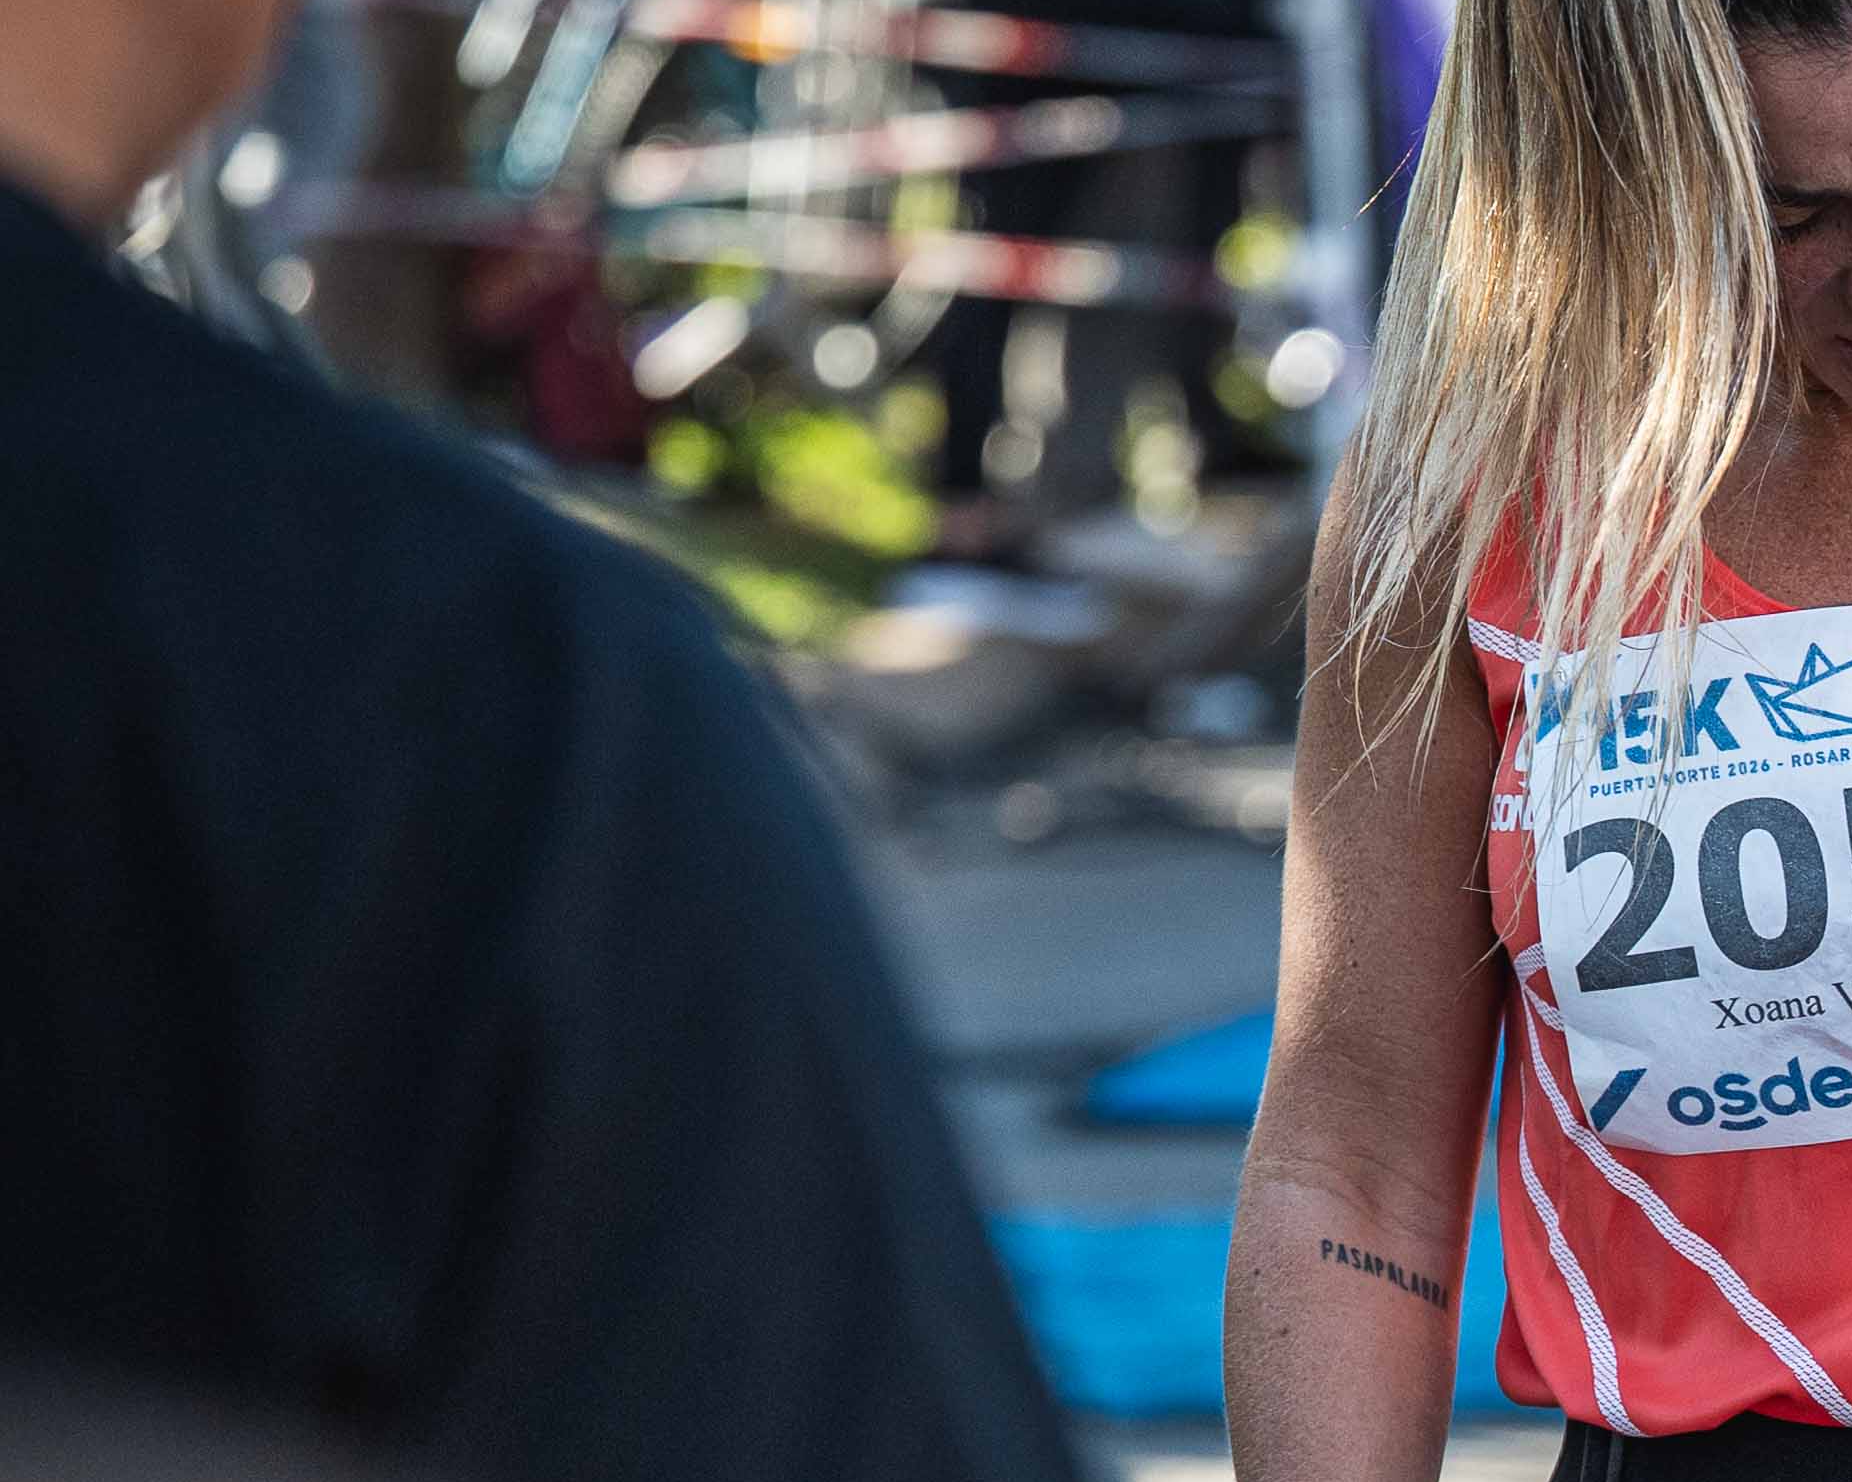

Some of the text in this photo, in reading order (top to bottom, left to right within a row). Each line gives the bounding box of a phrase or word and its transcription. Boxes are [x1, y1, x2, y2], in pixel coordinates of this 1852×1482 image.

[1588, 677, 1742, 771] 15K
[1589, 775, 1657, 799] PUERTO
[1662, 765, 1721, 787] NORTE
[1727, 758, 1770, 778] 2026
[1711, 993, 1826, 1030] Xoana
